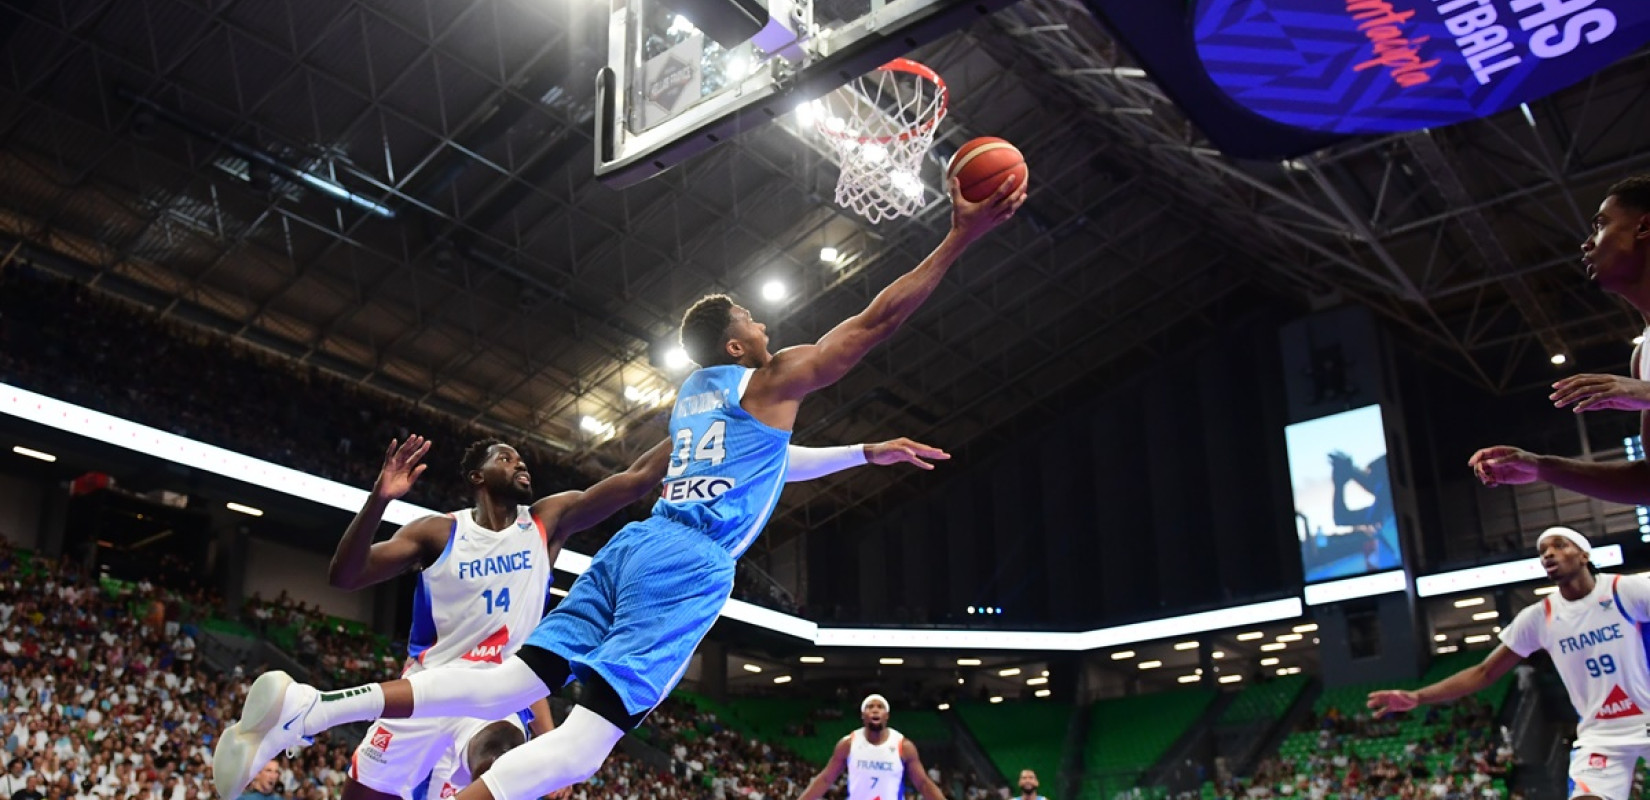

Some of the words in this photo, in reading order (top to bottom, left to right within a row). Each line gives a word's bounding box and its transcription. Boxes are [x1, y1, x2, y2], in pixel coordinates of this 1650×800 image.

[1431, 0, 1523, 86] TBALL
[667, 419, 727, 478] 34
[670, 478, 733, 502] EKO
[458, 549, 533, 580] FRANCE
[481, 586, 511, 615] 14
[469, 644, 506, 658] MAI
[1558, 622, 1625, 655] FRANCE
[1585, 653, 1617, 678] 99
[1600, 699, 1633, 717] MAIF
[856, 759, 894, 771] FRANCE
[870, 776, 879, 790] 7
